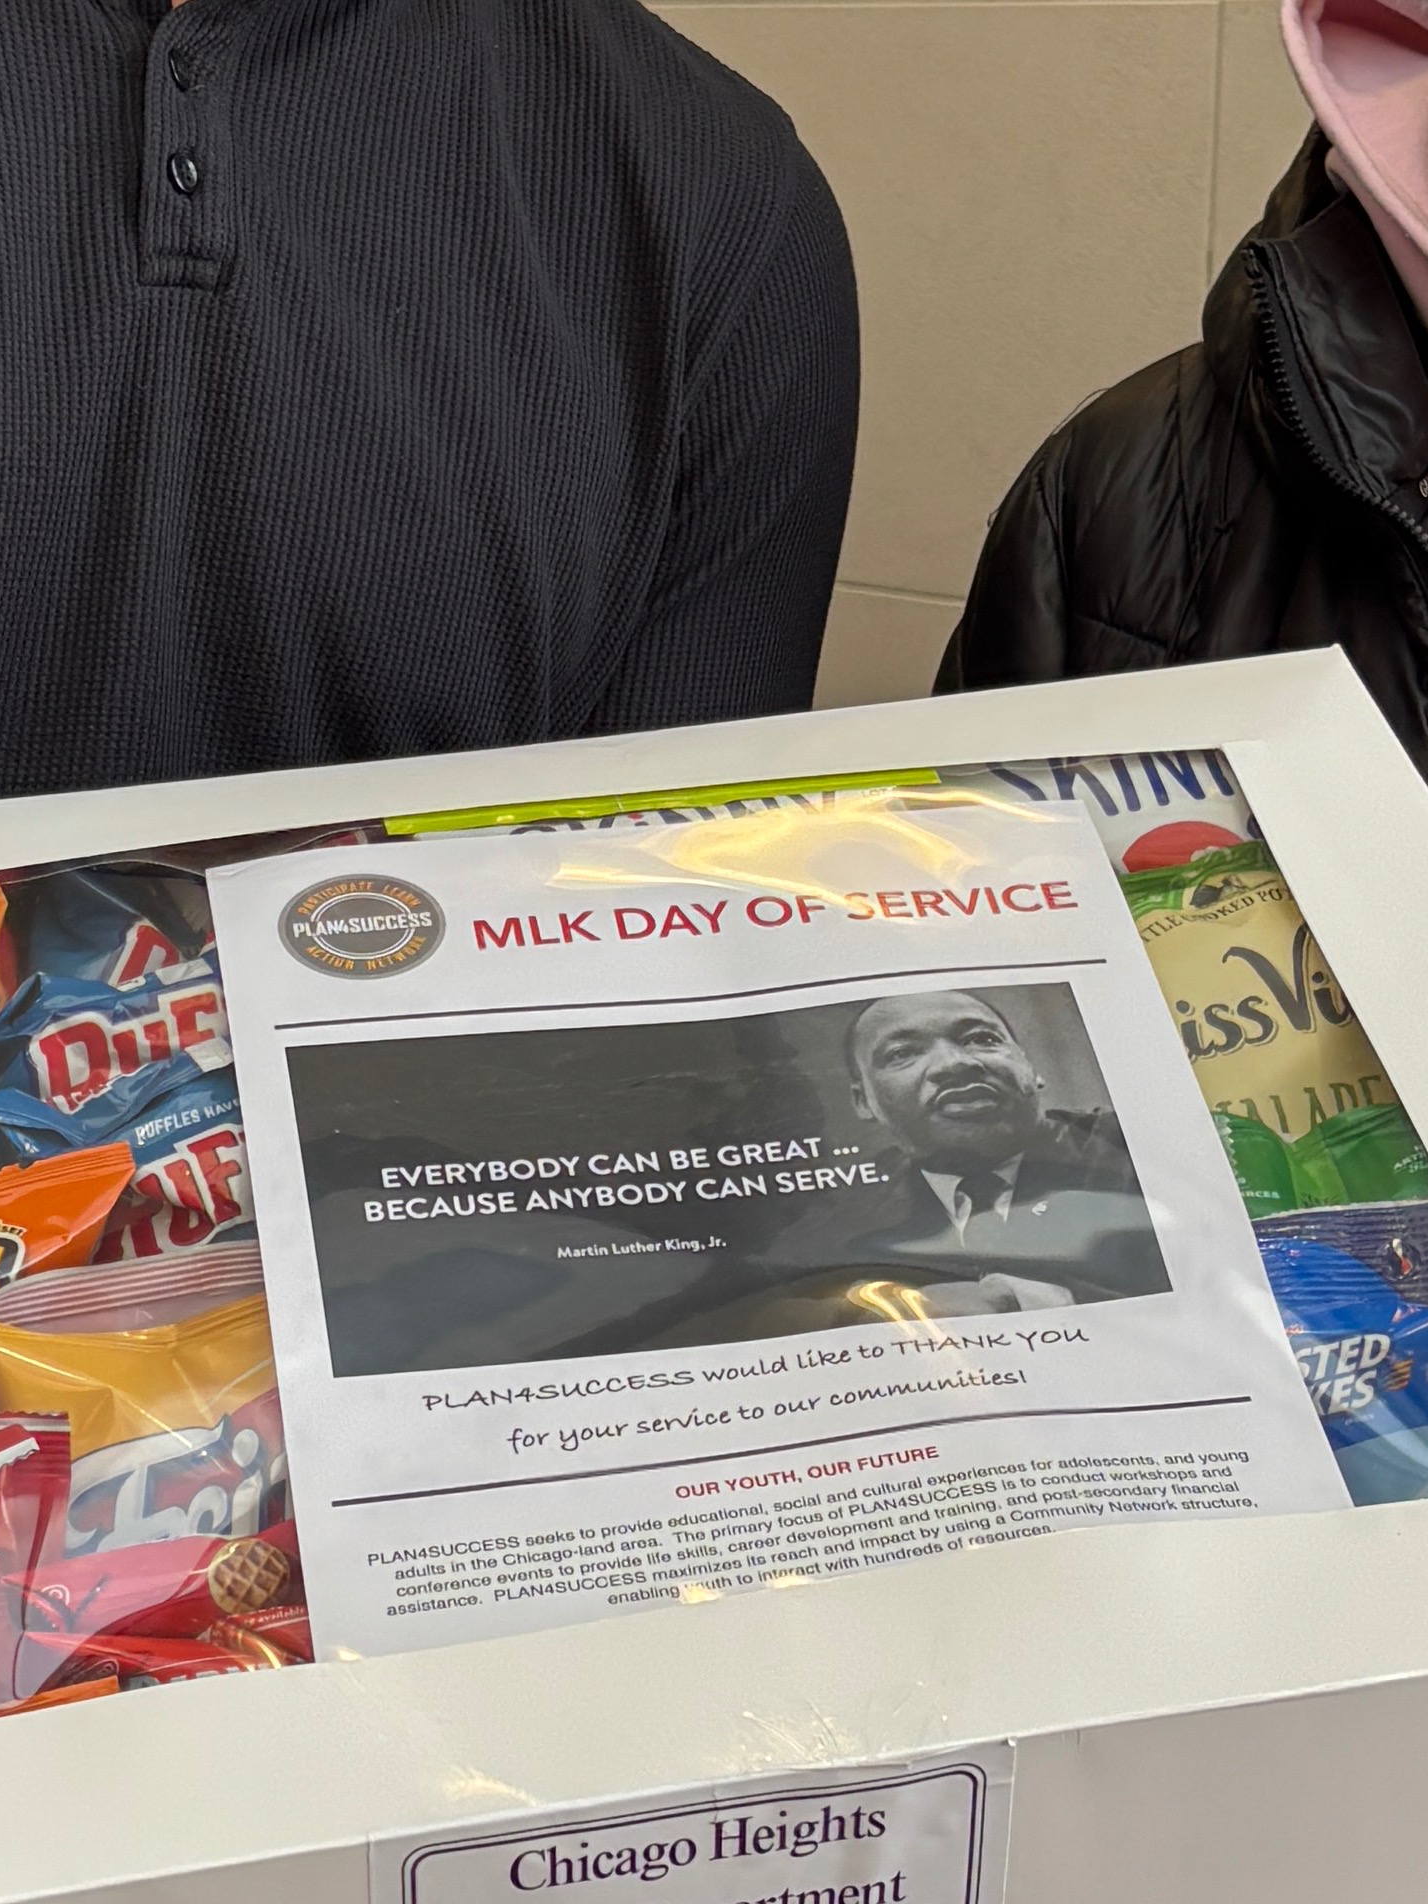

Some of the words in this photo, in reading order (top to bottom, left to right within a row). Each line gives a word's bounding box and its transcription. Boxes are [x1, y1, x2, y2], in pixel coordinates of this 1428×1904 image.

[292, 911, 433, 938] PLAN4SUCCESS
[472, 909, 602, 951] MLK
[615, 899, 729, 941] DAY
[745, 893, 828, 929] OF
[846, 880, 1080, 922] SERVICE
[305, 945, 355, 970] ACTION
[135, 1108, 201, 1146] RUFFLES
[380, 1155, 581, 1190] EVERYBODY
[587, 1149, 660, 1176] CAN
[669, 1146, 708, 1172] BE
[716, 1137, 822, 1167] GREAT
[363, 1190, 519, 1224] BECAUSE
[524, 1179, 689, 1213] ANYBODY
[694, 1173, 770, 1202] CAN
[776, 1161, 890, 1196] SERVE.
[556, 1242, 609, 1260] Martin
[610, 1239, 662, 1257] Luther
[664, 1235, 706, 1254] King,
[707, 1234, 728, 1250] Jr.
[421, 1368, 696, 1411] PLAN4SUCCESS
[702, 1353, 788, 1385] would
[797, 1344, 852, 1370] like
[857, 1340, 885, 1359] to
[891, 1333, 1013, 1357] THANK
[1016, 1327, 1090, 1353] YOU
[506, 1427, 550, 1455] for
[558, 1418, 630, 1451] your
[636, 1405, 732, 1435] service
[738, 1400, 767, 1421] to
[773, 1394, 821, 1417] our
[829, 1368, 1028, 1408] communities!
[367, 1536, 521, 1567] PLAN4SUCCESS
[525, 1531, 576, 1547] seeks
[579, 1527, 596, 1540] to
[600, 1518, 664, 1540] provide
[667, 1503, 770, 1530] educational,
[773, 1494, 822, 1513] social
[826, 1488, 859, 1505] and
[862, 1477, 923, 1499] cultural
[927, 1460, 1028, 1488] experiences
[1030, 1458, 1054, 1472] for
[1058, 1453, 1160, 1471] adolescents,
[1164, 1450, 1195, 1466] and
[1198, 1449, 1250, 1468] young
[676, 1482, 721, 1500] OUR
[724, 1470, 803, 1494] YOUTH,
[806, 1461, 853, 1480] OUR
[857, 1445, 940, 1472] FUTURE
[386, 1593, 483, 1617] assistance.
[494, 1571, 647, 1602] PLAN4SUCCESS
[652, 1559, 743, 1583] maximizes
[747, 1555, 767, 1567] its
[771, 1546, 819, 1563] reach
[824, 1538, 856, 1555] and
[860, 1530, 917, 1549] impact
[921, 1525, 940, 1541] by
[945, 1517, 991, 1535] using
[1010, 1502, 1104, 1523] Community
[1109, 1498, 1178, 1513] Network
[1181, 1495, 1259, 1511] structure,
[394, 1562, 446, 1581] adults
[450, 1560, 467, 1574] in
[471, 1555, 498, 1570] the
[502, 1543, 616, 1568] Chicago-land
[620, 1536, 664, 1552] area.
[672, 1529, 709, 1545] The
[710, 1520, 773, 1541] primary
[778, 1510, 824, 1529] focus
[827, 1507, 845, 1521] of
[848, 1480, 998, 1516] PLAN4SUCCESS
[1001, 1478, 1018, 1492] is
[1020, 1475, 1037, 1489] to
[1041, 1470, 1106, 1486] conduct
[1109, 1466, 1198, 1484] workshops
[1201, 1465, 1233, 1479] and
[395, 1576, 492, 1599] conference
[496, 1568, 554, 1585] events
[558, 1564, 575, 1577] to
[579, 1555, 643, 1577] provide
[647, 1551, 672, 1566] life
[676, 1545, 723, 1561] skills,
[728, 1537, 781, 1553] career
[786, 1516, 895, 1544] development
[899, 1509, 930, 1525] and
[934, 1498, 1002, 1521] training,
[1007, 1491, 1038, 1508] and
[1042, 1483, 1168, 1504] post-secondary
[1171, 1480, 1241, 1496] financial
[608, 1585, 680, 1606] enabling
[736, 1574, 754, 1586] to
[758, 1562, 821, 1582] interact
[825, 1556, 860, 1572] with
[864, 1543, 944, 1565] hundreds
[947, 1538, 965, 1551] of
[968, 1525, 1057, 1546] resources.
[508, 1834, 698, 1893] Chicago
[709, 1803, 888, 1865] Heights
